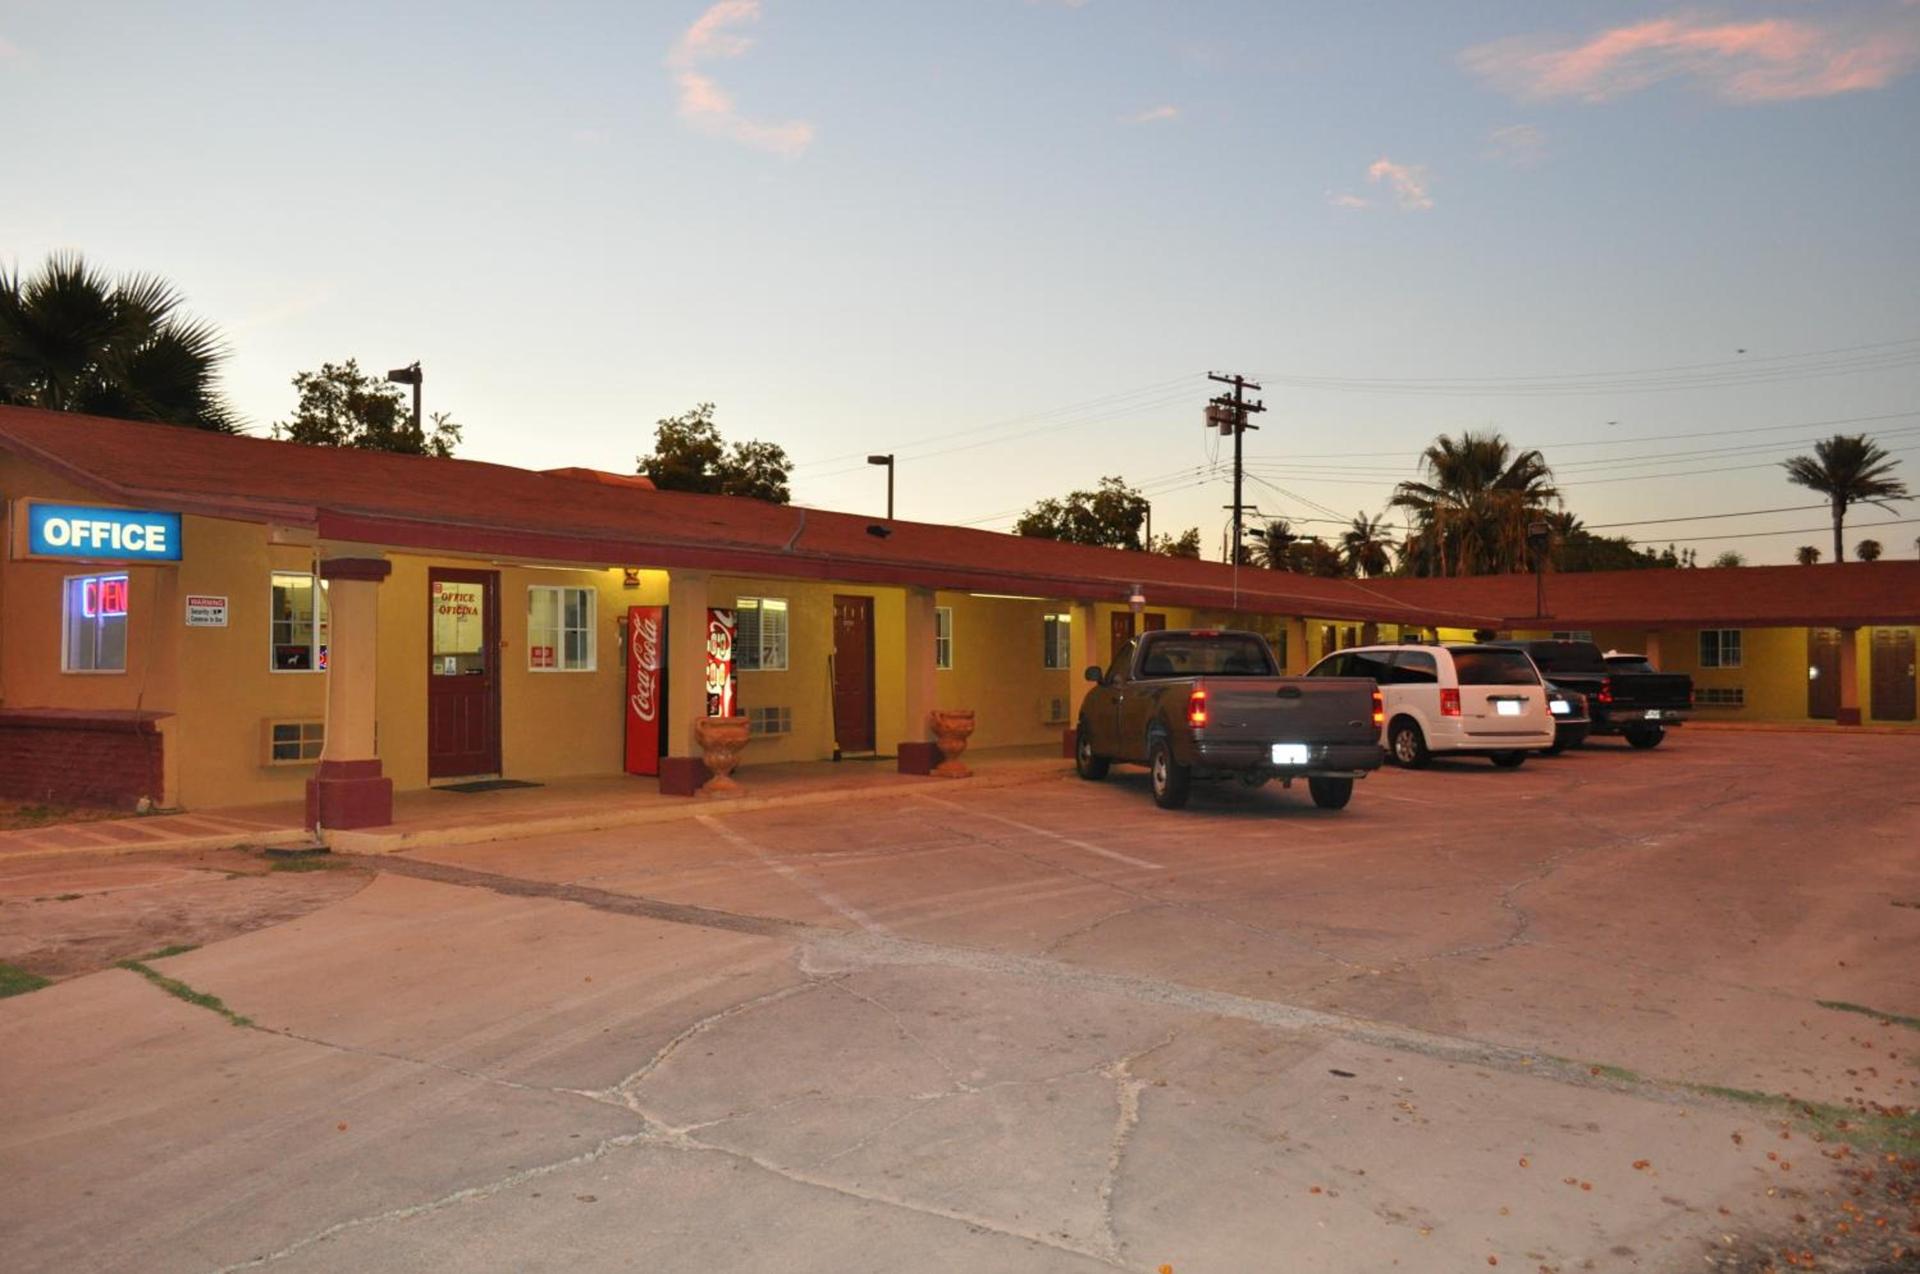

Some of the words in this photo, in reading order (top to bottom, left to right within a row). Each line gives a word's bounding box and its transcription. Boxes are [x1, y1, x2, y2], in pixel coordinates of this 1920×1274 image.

[43, 517, 166, 552] OFFICE
[441, 593, 475, 602] OFFICE
[190, 599, 224, 607] WARNING
[439, 605, 478, 615] OFICINA
